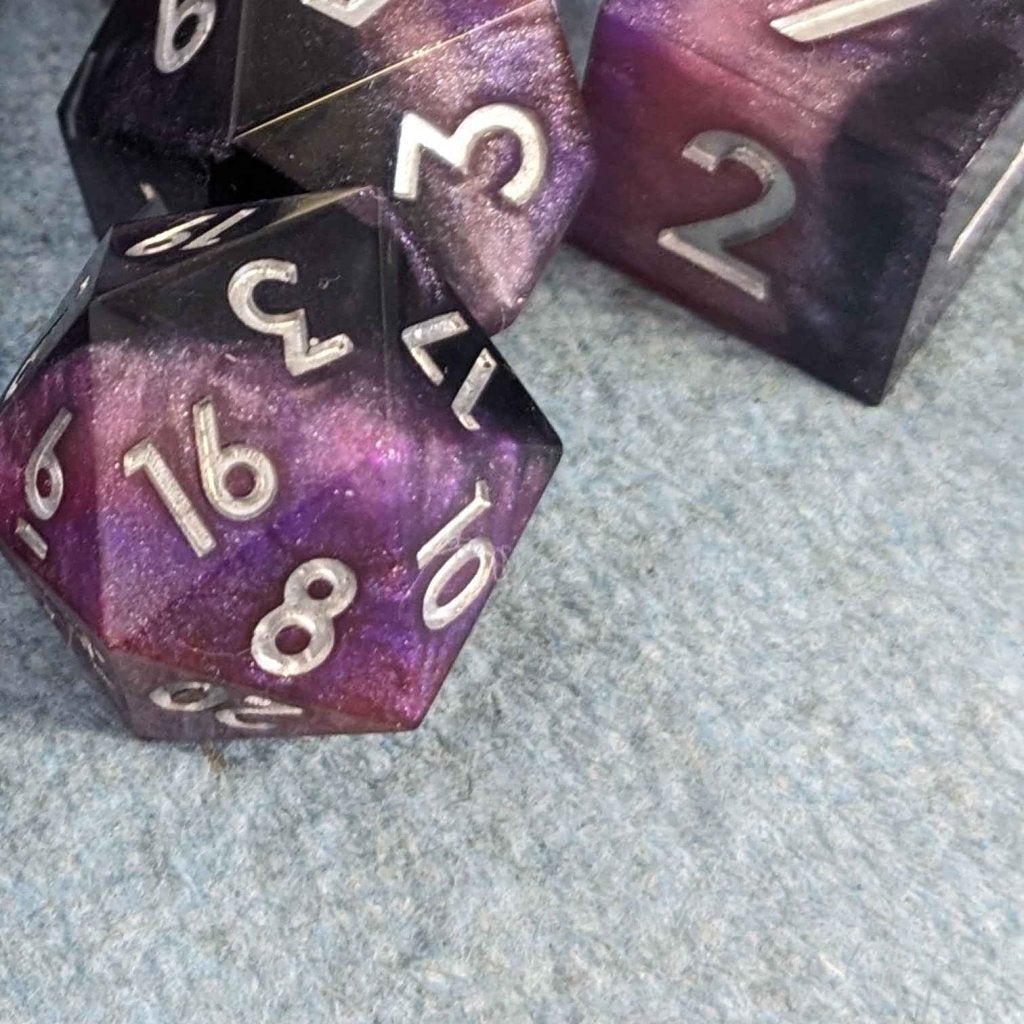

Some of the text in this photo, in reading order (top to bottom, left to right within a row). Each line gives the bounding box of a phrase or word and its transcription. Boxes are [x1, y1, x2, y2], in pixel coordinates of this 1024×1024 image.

[392, 102, 549, 208] 3
[657, 129, 797, 302] 2
[227, 258, 354, 376] 3
[122, 396, 277, 558] 16
[250, 556, 358, 677] 8
[416, 478, 497, 631] 10
